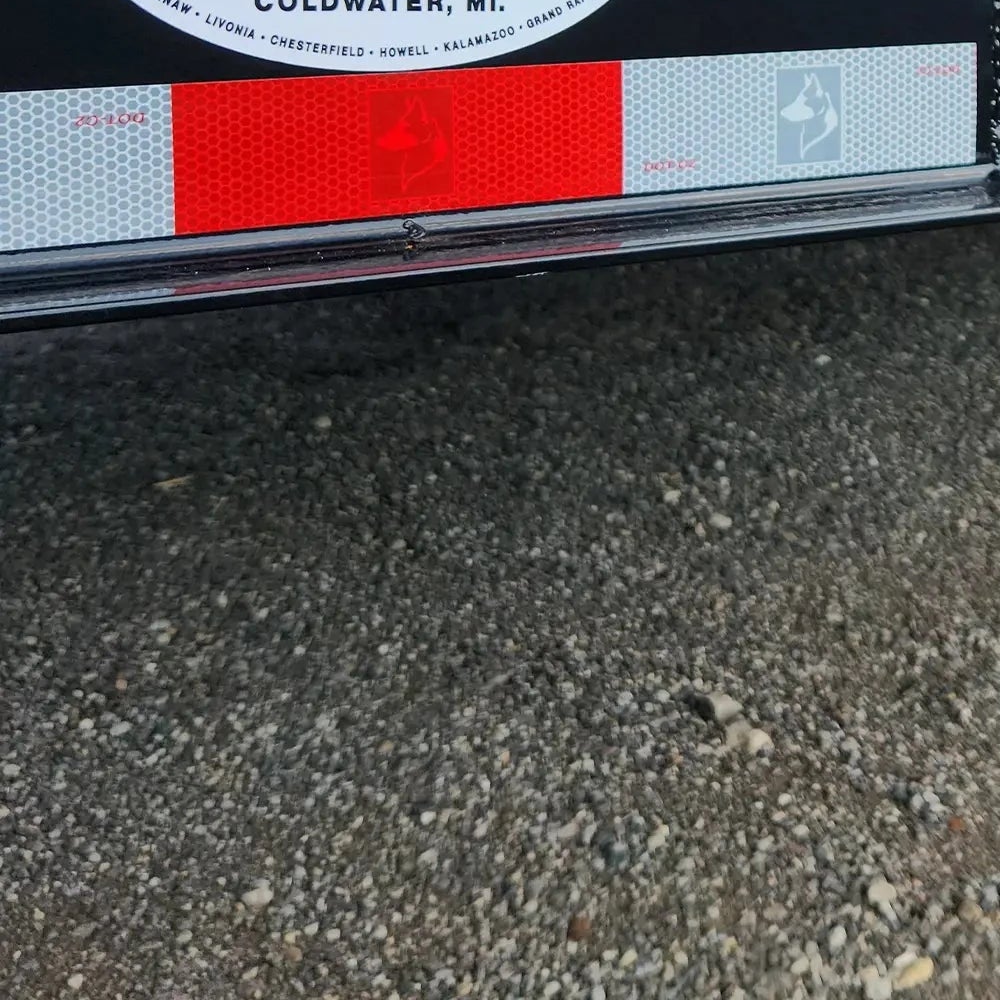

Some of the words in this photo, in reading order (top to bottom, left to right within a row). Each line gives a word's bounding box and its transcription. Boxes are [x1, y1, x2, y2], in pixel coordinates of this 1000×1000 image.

[205, 13, 256, 40] LIVONIA
[270, 35, 365, 58] CHESTERFIELD
[379, 44, 429, 57] HOWELL
[443, 25, 516, 53] KALAMAZOO
[526, 9, 564, 29] GRAND
